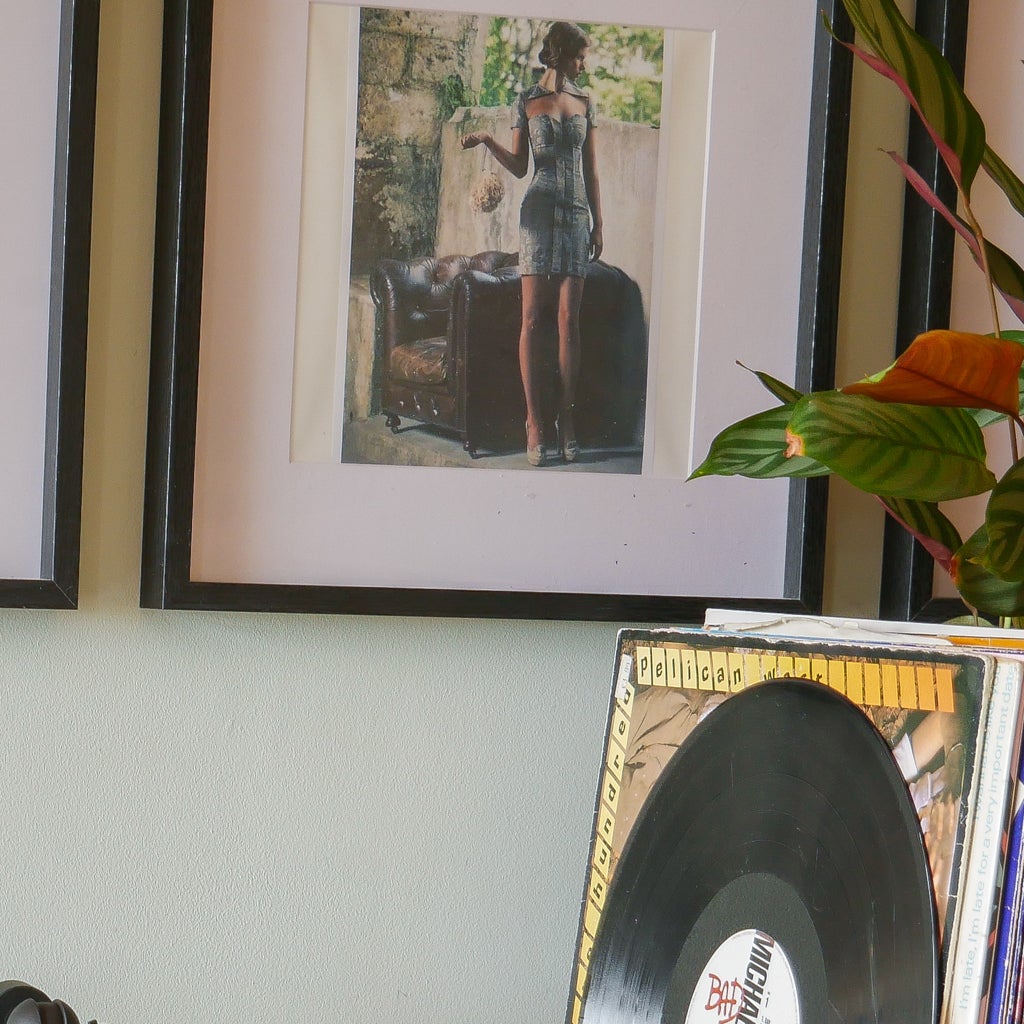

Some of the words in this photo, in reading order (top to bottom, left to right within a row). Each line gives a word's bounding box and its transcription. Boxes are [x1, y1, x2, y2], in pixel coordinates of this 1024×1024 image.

[990, 705, 1008, 793] important
[985, 797, 998, 835] very
[978, 852, 988, 877] for
[973, 881, 985, 913] late
